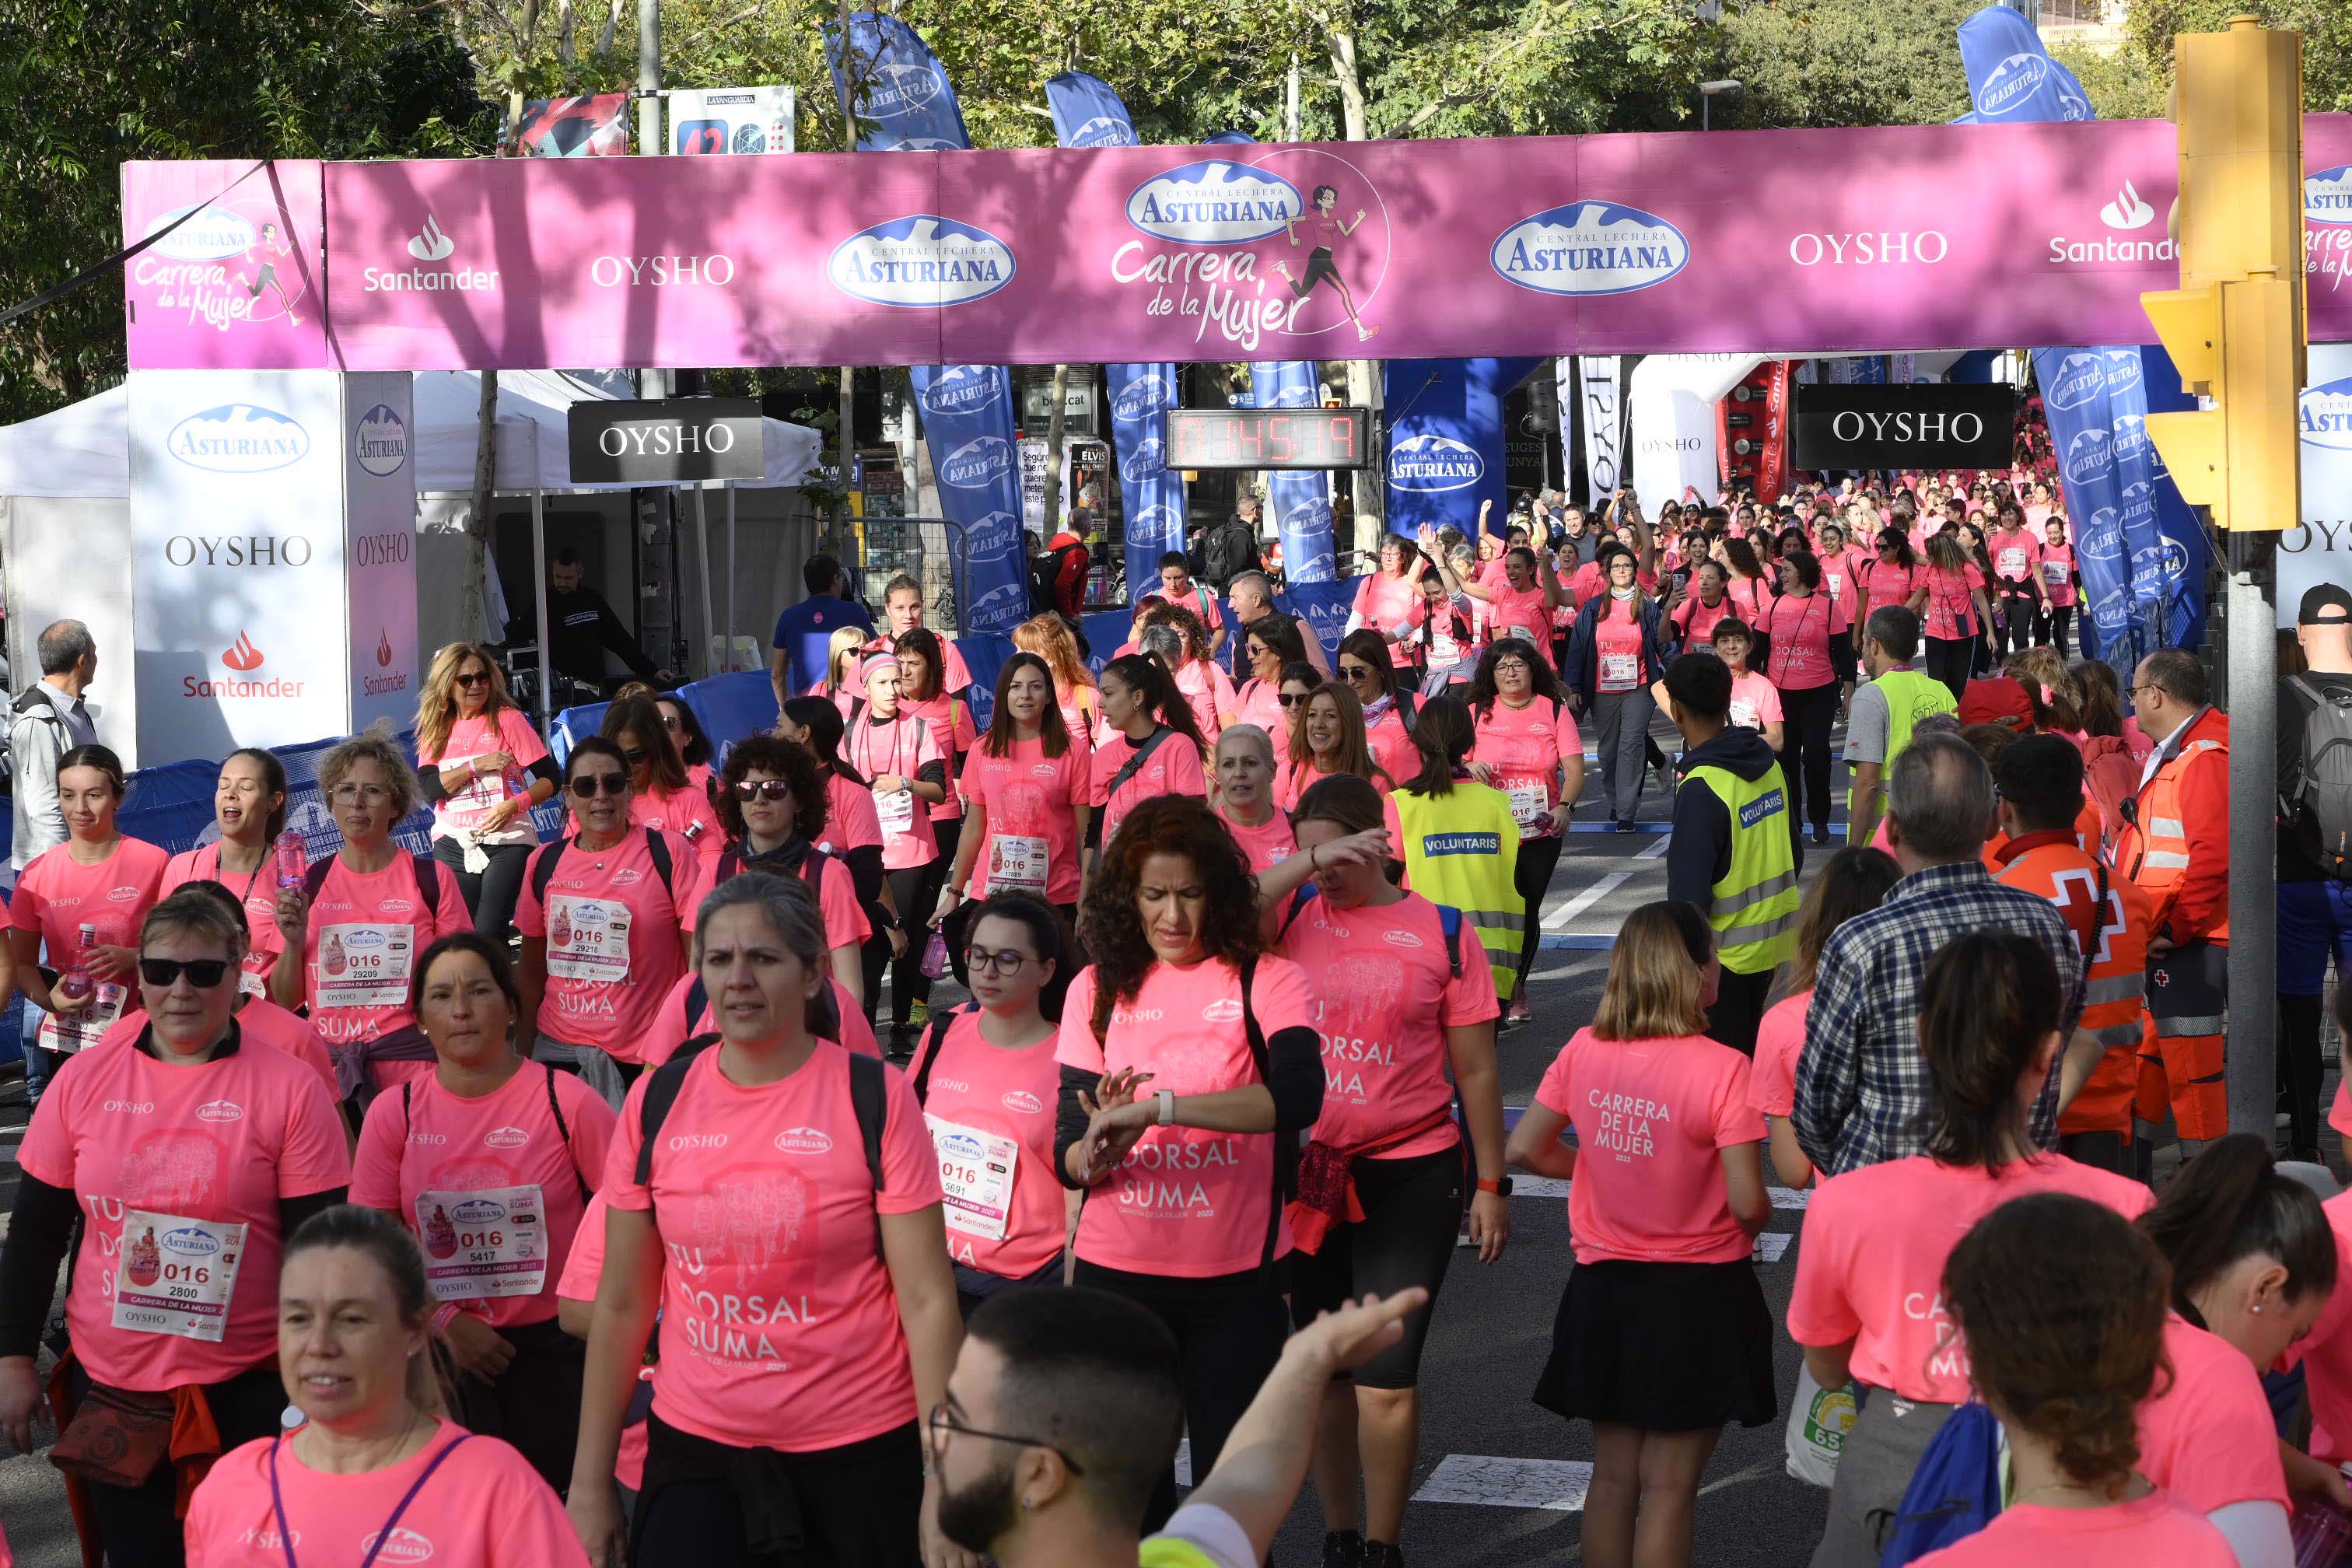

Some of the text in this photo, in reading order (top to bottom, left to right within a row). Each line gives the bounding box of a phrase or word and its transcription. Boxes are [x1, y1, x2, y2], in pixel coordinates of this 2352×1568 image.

[1167, 187, 1284, 198] CENTRAL LECHERA
[1139, 193, 1288, 223] ASTURIANA
[1536, 232, 1668, 243] CENTRAL LECHERA
[872, 246, 994, 257] CENTRAL LECHERA
[1507, 237, 1674, 273] ASTURIANA
[1790, 231, 1948, 265] OYSHO
[846, 250, 1001, 283] ASTURIANA
[1111, 241, 1255, 284] Carrera
[2322, 250, 2336, 273] la
[135, 256, 226, 286] Carrera
[591, 254, 734, 287] OYSHO
[364, 267, 499, 292] Santander
[158, 283, 261, 331] de la Mujer
[1146, 279, 1311, 351] de la Mujer
[1832, 411, 1983, 443] OYSHO
[179, 430, 300, 456] ASTURIANA
[359, 431, 404, 459] ASTURIANA
[600, 423, 734, 457] OYSHO
[1642, 437, 1701, 452] OYSHO
[1082, 451, 1105, 461] ELVIS
[1024, 464, 1038, 473] que
[1391, 463, 1477, 479] ASTURIANA
[1763, 442, 1777, 492] Sports
[166, 536, 312, 566] OYSHO
[357, 532, 408, 566] OYSHO
[1774, 635, 1785, 643] TU
[1776, 646, 1815, 656] DORSAL
[1776, 659, 1804, 667] SUMA
[184, 676, 304, 698] Santander
[364, 671, 407, 697] Santander
[1512, 807, 1531, 817] 016
[1426, 836, 1498, 852] VOLUNTARIS
[1003, 860, 1025, 870] 016
[573, 929, 603, 943] 016
[576, 944, 598, 954] 29210
[349, 954, 381, 968] 016
[352, 970, 378, 978] 29209
[558, 993, 614, 1014] SUMA
[318, 1017, 381, 1037] SUMA
[104, 1100, 155, 1115] OYSHO
[199, 1105, 240, 1120] ASTURIANA
[1588, 1089, 1671, 1122] CARRERA
[1601, 1110, 1650, 1138] DE LA
[488, 1135, 527, 1144] ASTURIANA
[670, 1134, 728, 1151] OYSHO
[779, 1136, 828, 1150] ASTURIANA
[1594, 1130, 1654, 1158] MUJER
[943, 1139, 981, 1159] ASTURIANA
[988, 1149, 1008, 1159] SUMA
[1615, 1154, 1631, 1164] 2023
[942, 1163, 976, 1184] 016
[945, 1182, 966, 1195] 5691
[1119, 1179, 1210, 1208] SUMA
[86, 1195, 123, 1221] TU
[455, 1209, 502, 1219] ASTURIANA
[959, 1200, 981, 1213] MUJER
[981, 1207, 996, 1216] 2023
[1196, 1209, 1214, 1218] 2023
[963, 1216, 996, 1231] Santander
[166, 1236, 215, 1251] ASTURIANA
[461, 1230, 503, 1248] 016
[470, 1251, 495, 1262] 5417
[668, 1241, 704, 1276] TU
[164, 1263, 210, 1283] 016
[437, 1266, 470, 1276] CARRERA
[436, 1282, 472, 1293] OYSHO
[502, 1277, 540, 1288] Santander
[169, 1286, 198, 1299] 2800
[131, 1296, 166, 1307] CARRERA
[191, 1305, 217, 1314] MUJER
[681, 1281, 817, 1325] DORSAL
[125, 1311, 166, 1325] OYSHO
[686, 1316, 781, 1360] SUMA
